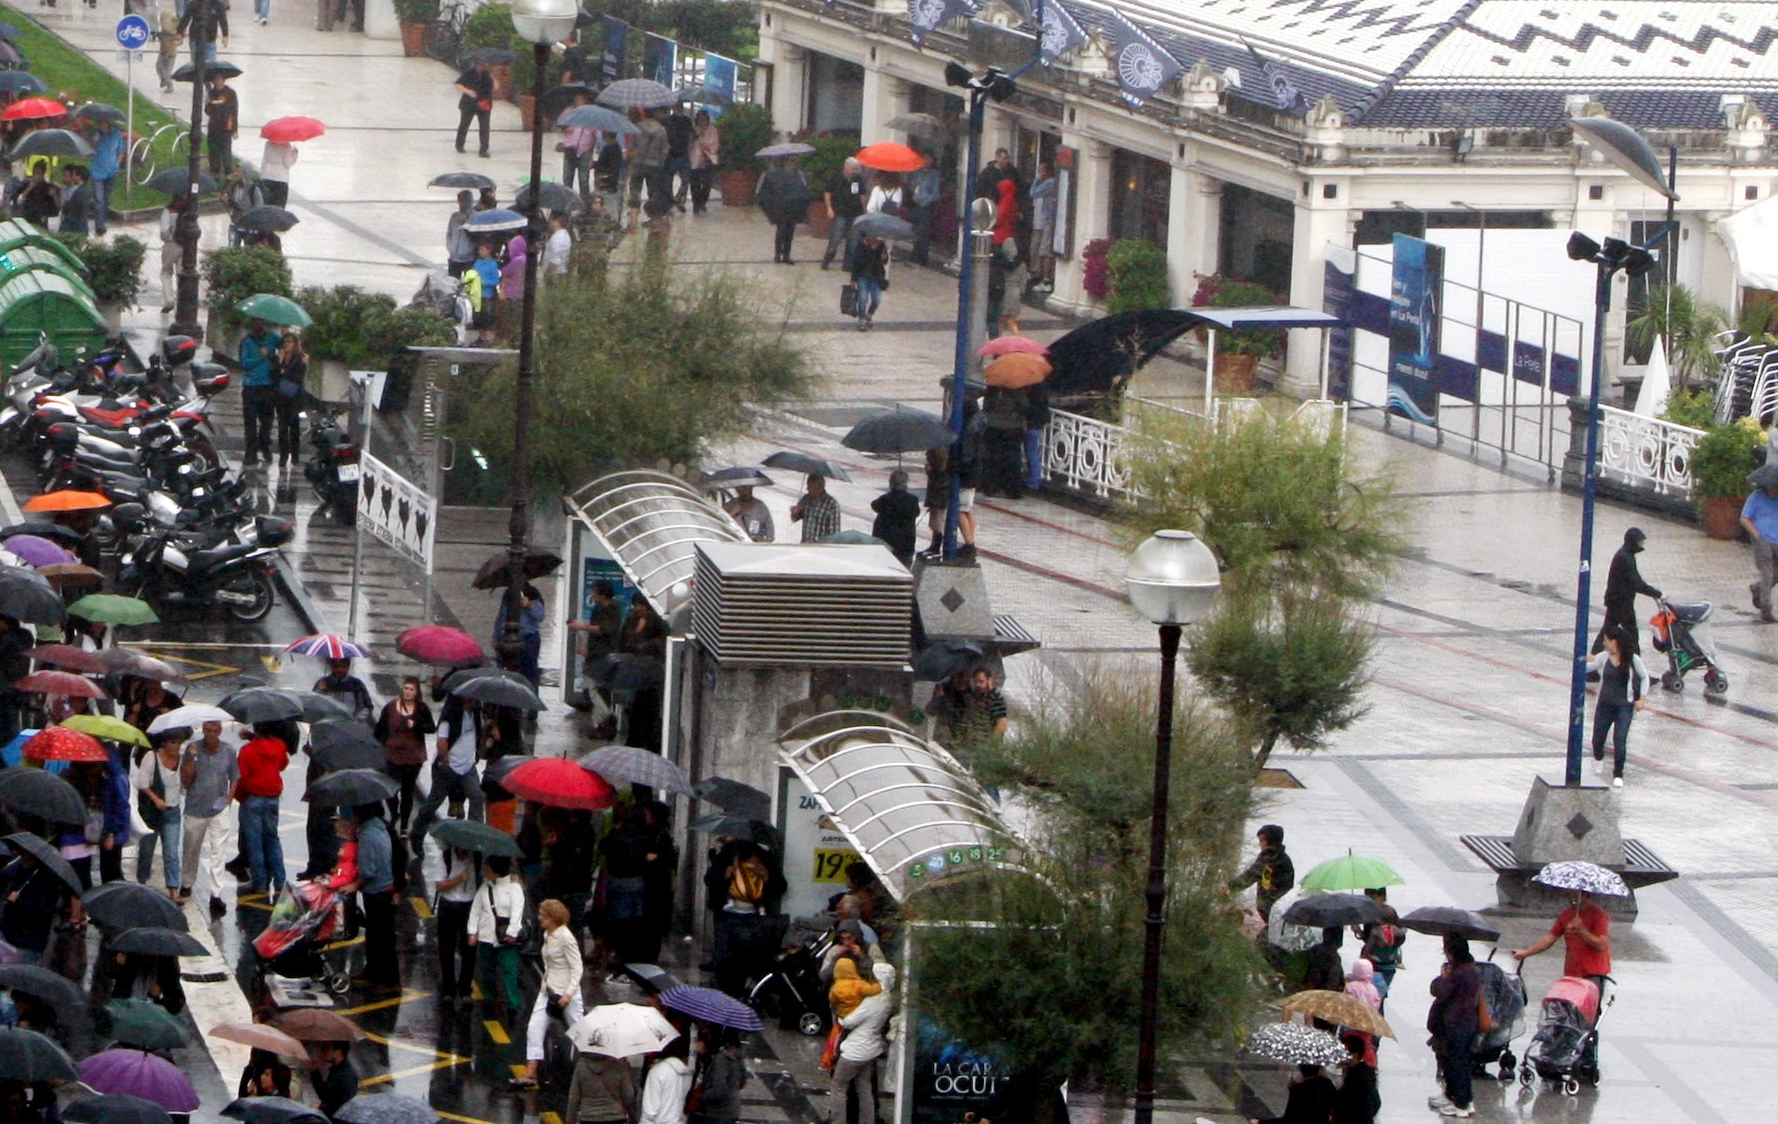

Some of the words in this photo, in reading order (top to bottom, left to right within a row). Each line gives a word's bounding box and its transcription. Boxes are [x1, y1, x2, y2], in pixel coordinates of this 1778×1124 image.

[799, 795, 822, 811] ZAP
[949, 852, 961, 863] 16
[933, 1062, 952, 1075] LA
